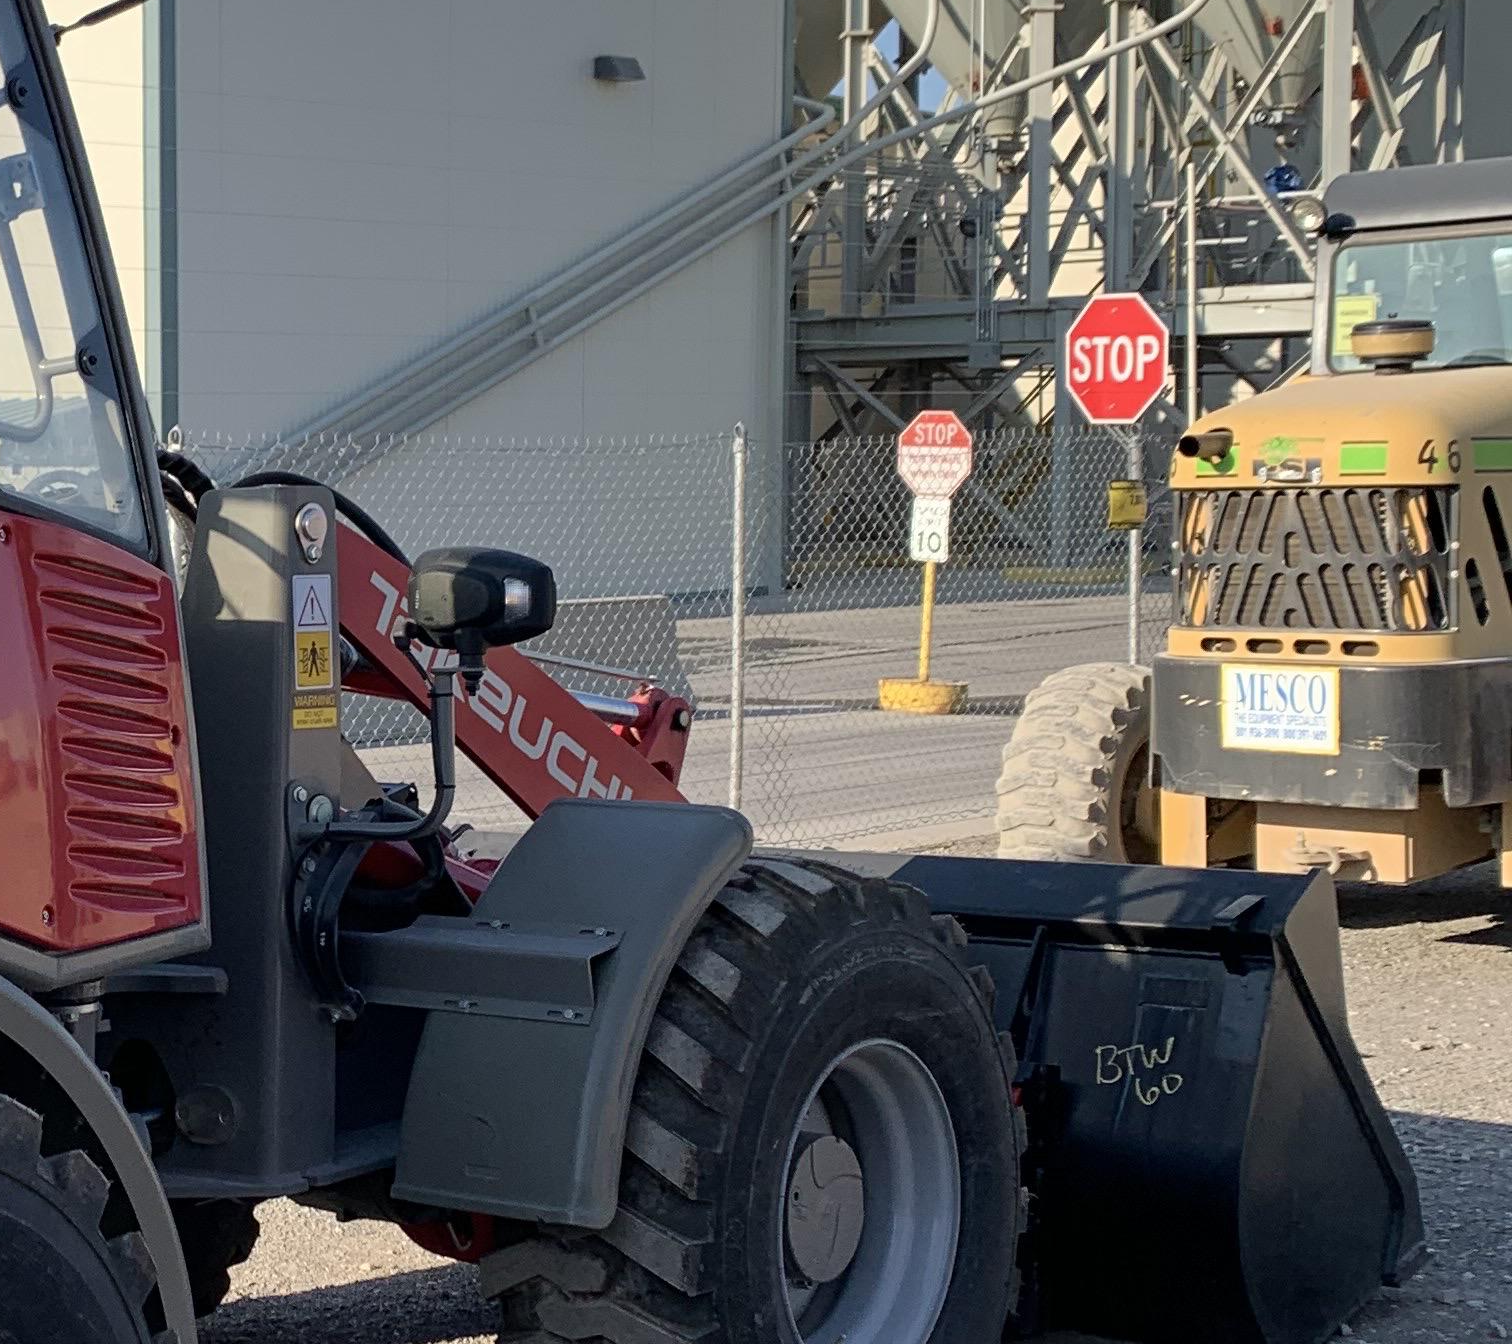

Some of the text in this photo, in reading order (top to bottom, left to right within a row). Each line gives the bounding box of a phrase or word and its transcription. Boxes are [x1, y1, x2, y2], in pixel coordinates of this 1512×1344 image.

[1073, 335, 1160, 383] STOP
[914, 422, 958, 445] STOP
[1417, 439, 1461, 474] 46
[917, 531, 942, 554] 10
[294, 694, 336, 707] WARNING
[370, 571, 632, 800] TEUCH
[1234, 672, 1326, 715] MESCO
[1095, 1037, 1175, 1084] BTW
[1135, 1074, 1183, 1106] 60
